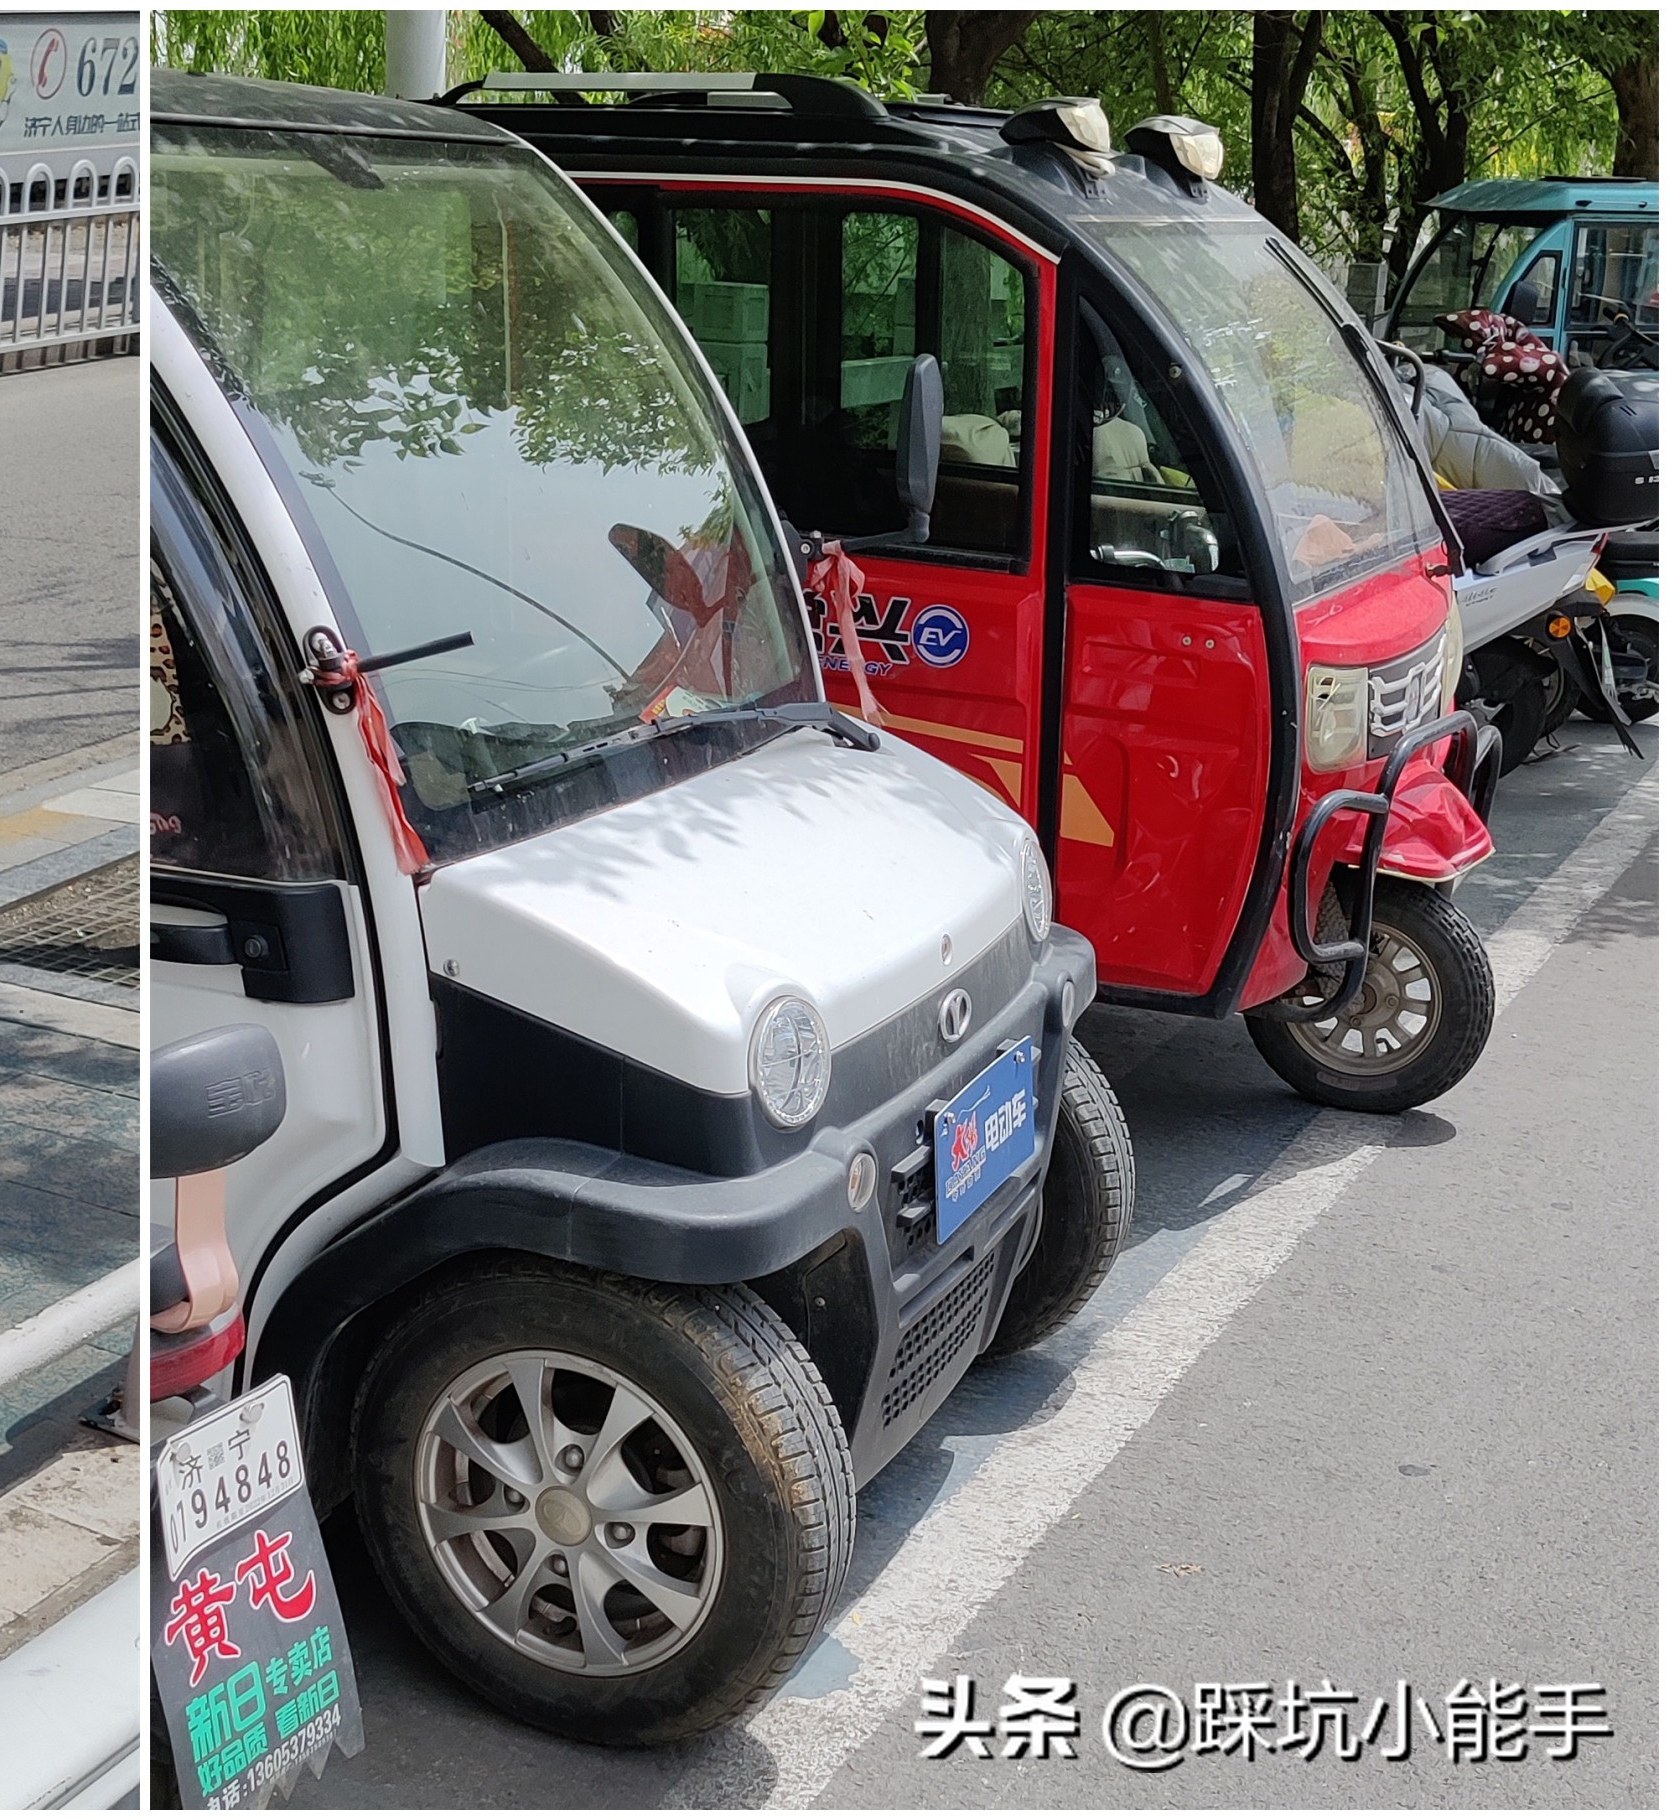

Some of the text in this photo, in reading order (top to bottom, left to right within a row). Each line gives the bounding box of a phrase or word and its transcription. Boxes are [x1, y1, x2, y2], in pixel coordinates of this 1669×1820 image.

[77, 36, 139, 97] 672
[818, 656, 892, 677] NEGY
[919, 627, 962, 647] EV
[985, 1088, 1027, 1152] 电动车
[164, 1529, 317, 1688] 黄屯
[185, 1660, 267, 1765] 新日
[265, 1624, 333, 1696] 专卖店
[197, 1721, 269, 1798] 好品质
[274, 1669, 341, 1740] 看新日
